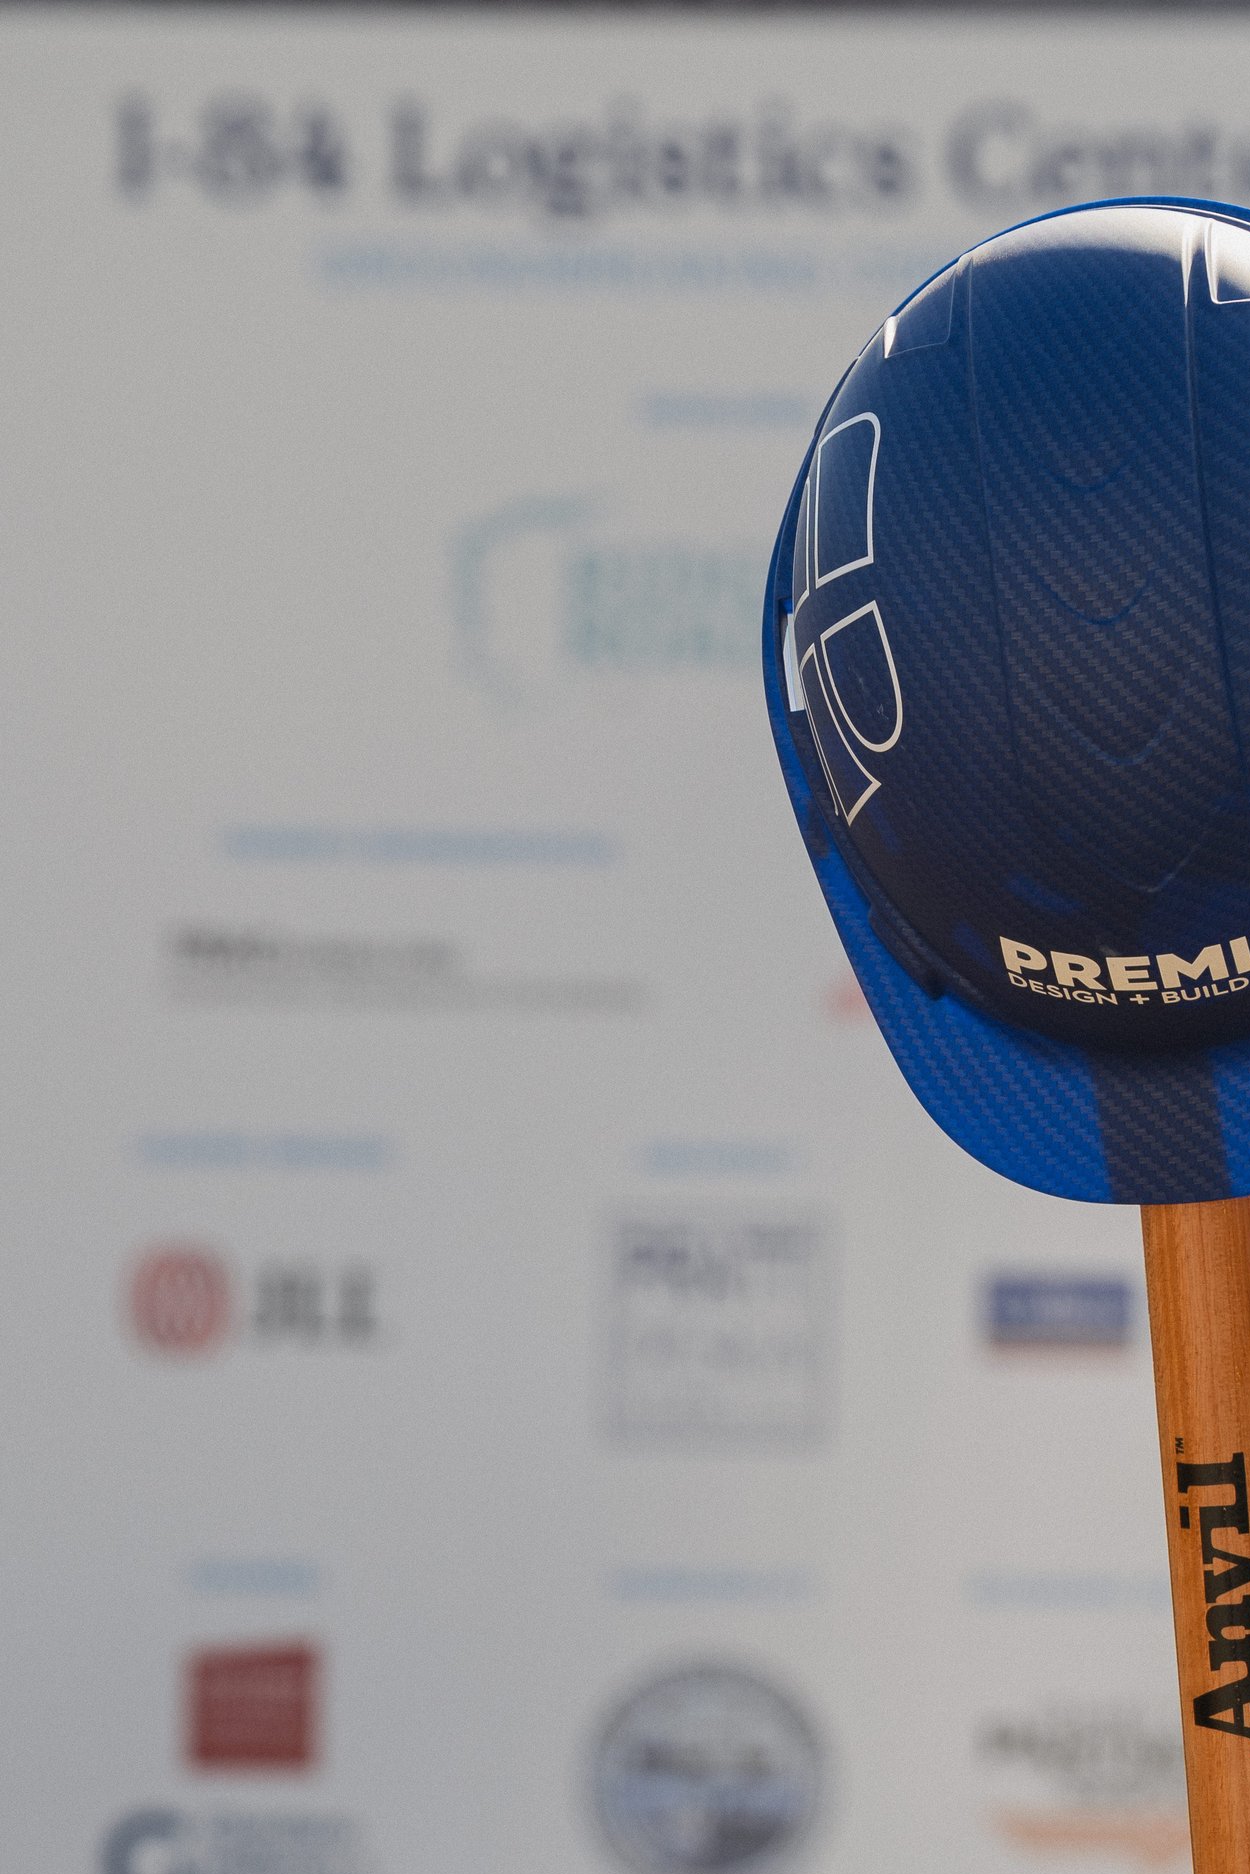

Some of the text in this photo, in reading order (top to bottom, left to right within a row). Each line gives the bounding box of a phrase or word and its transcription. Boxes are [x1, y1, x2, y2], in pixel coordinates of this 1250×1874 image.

[388, 94, 914, 224] Logistics
[1007, 972, 1119, 1006] DESIGN
[1161, 976, 1250, 1004] BUILD
